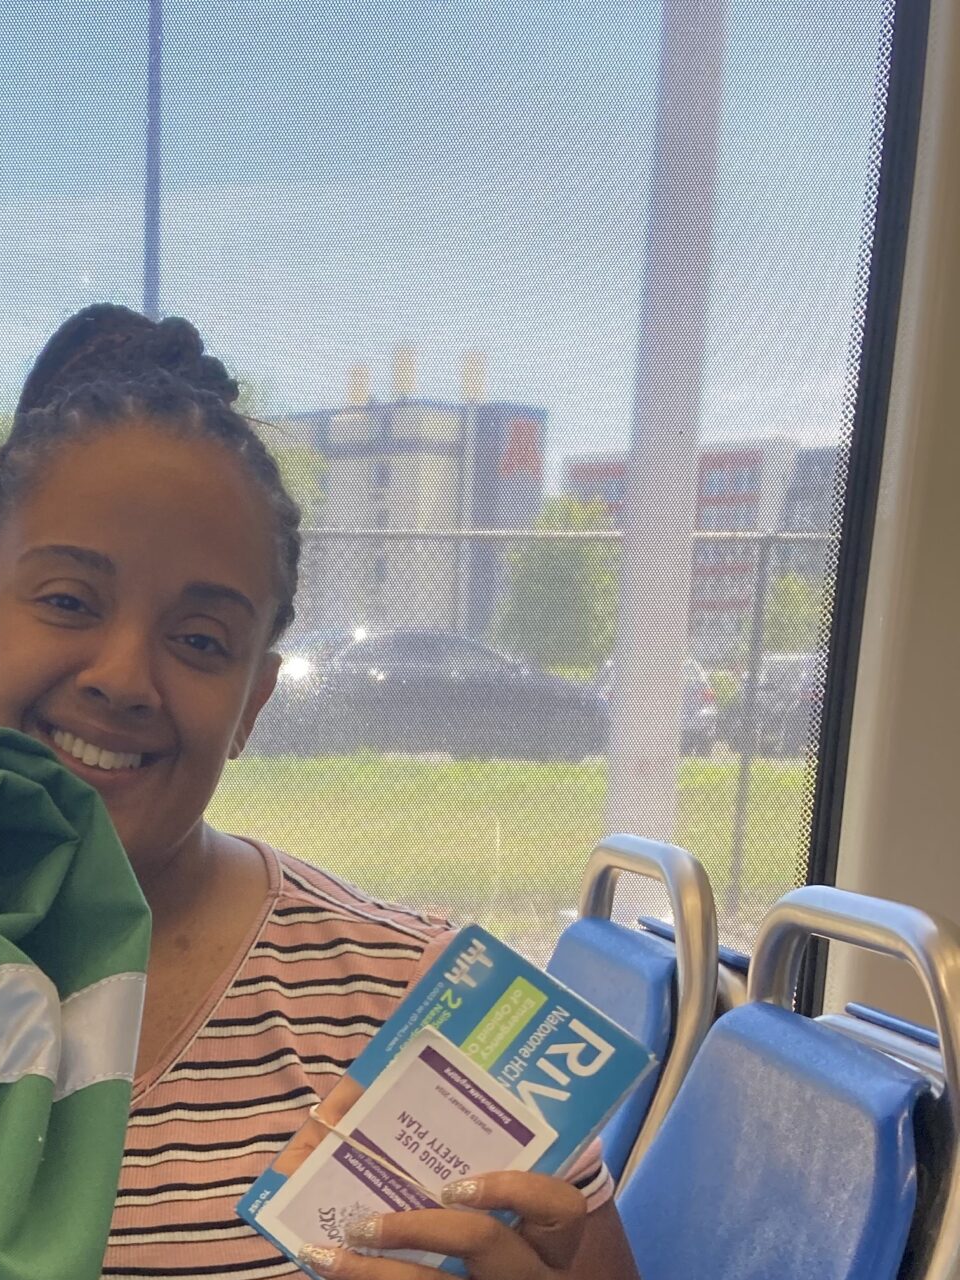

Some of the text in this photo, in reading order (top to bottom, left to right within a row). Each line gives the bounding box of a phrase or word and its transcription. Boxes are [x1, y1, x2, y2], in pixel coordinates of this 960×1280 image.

[439, 988, 462, 1009] 2
[517, 1005, 571, 1059] Naloxone
[393, 1128, 421, 1154] USE
[395, 1109, 471, 1176] SAFETY PLAN
[343, 1151, 366, 1172] PEOPLE
[417, 1148, 452, 1181] DRUG
[362, 1168, 383, 1188] YOUNG
[258, 1188, 272, 1201] TO
